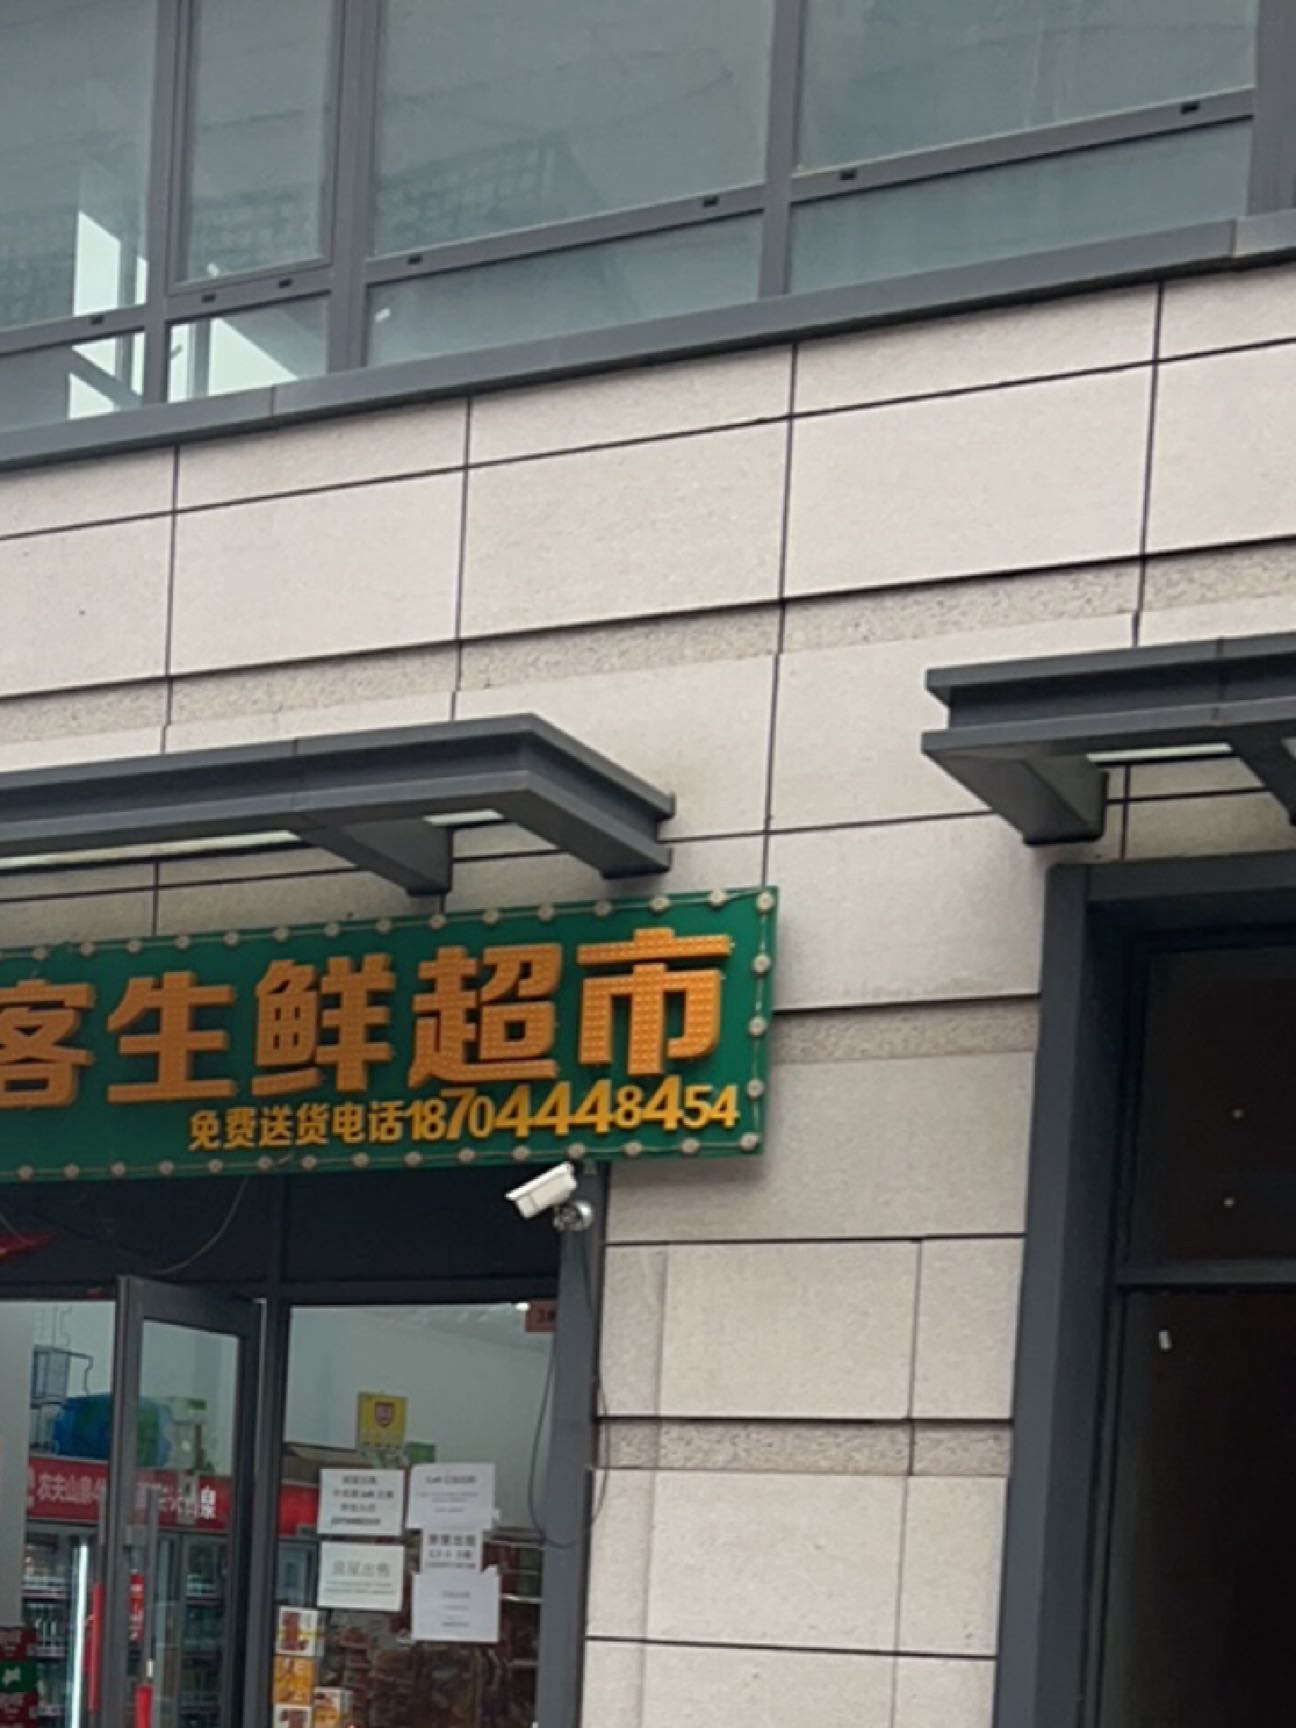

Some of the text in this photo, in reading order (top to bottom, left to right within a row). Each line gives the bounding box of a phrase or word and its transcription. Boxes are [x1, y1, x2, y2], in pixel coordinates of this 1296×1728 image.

[188, 1074, 739, 1151] 免费送货电话18704448454
